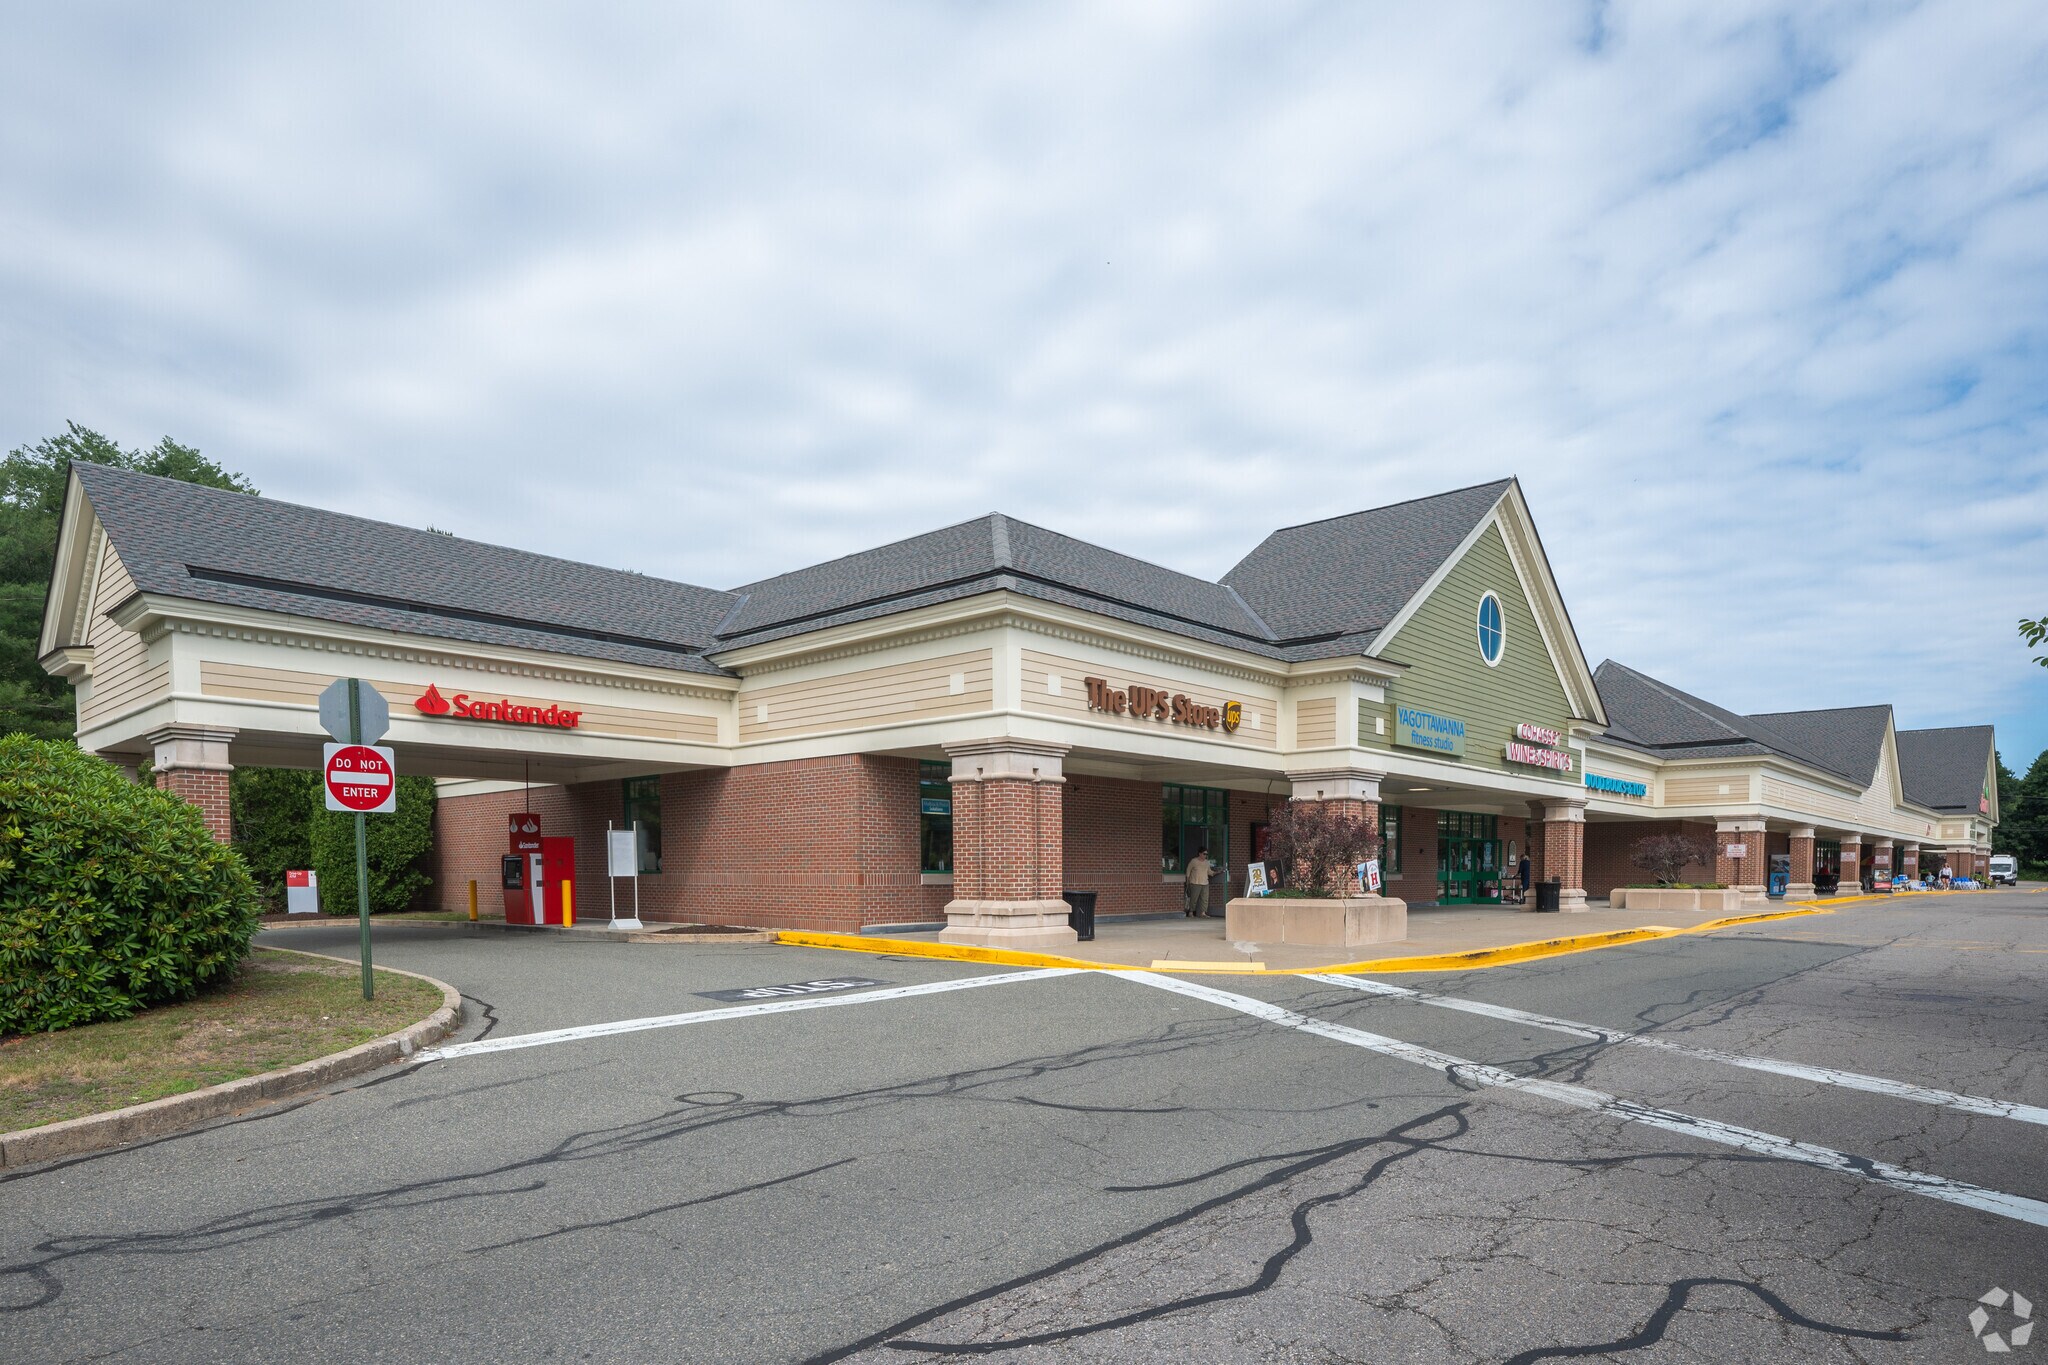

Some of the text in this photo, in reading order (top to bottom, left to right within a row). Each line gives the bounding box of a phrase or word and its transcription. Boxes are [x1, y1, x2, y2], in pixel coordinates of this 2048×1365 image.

[452, 694, 582, 728] Santander
[1085, 677, 1219, 729] The UPS Store
[1227, 710, 1240, 725] ups
[1398, 707, 1464, 738] YAGOTTAWANNA
[1411, 729, 1454, 751] fitness studio
[1519, 723, 1562, 746] COHASSET
[336, 758, 383, 770] DO NOT
[1506, 742, 1534, 764] WINE
[1540, 748, 1572, 772] SPIRITS
[343, 787, 378, 798] ENTER
